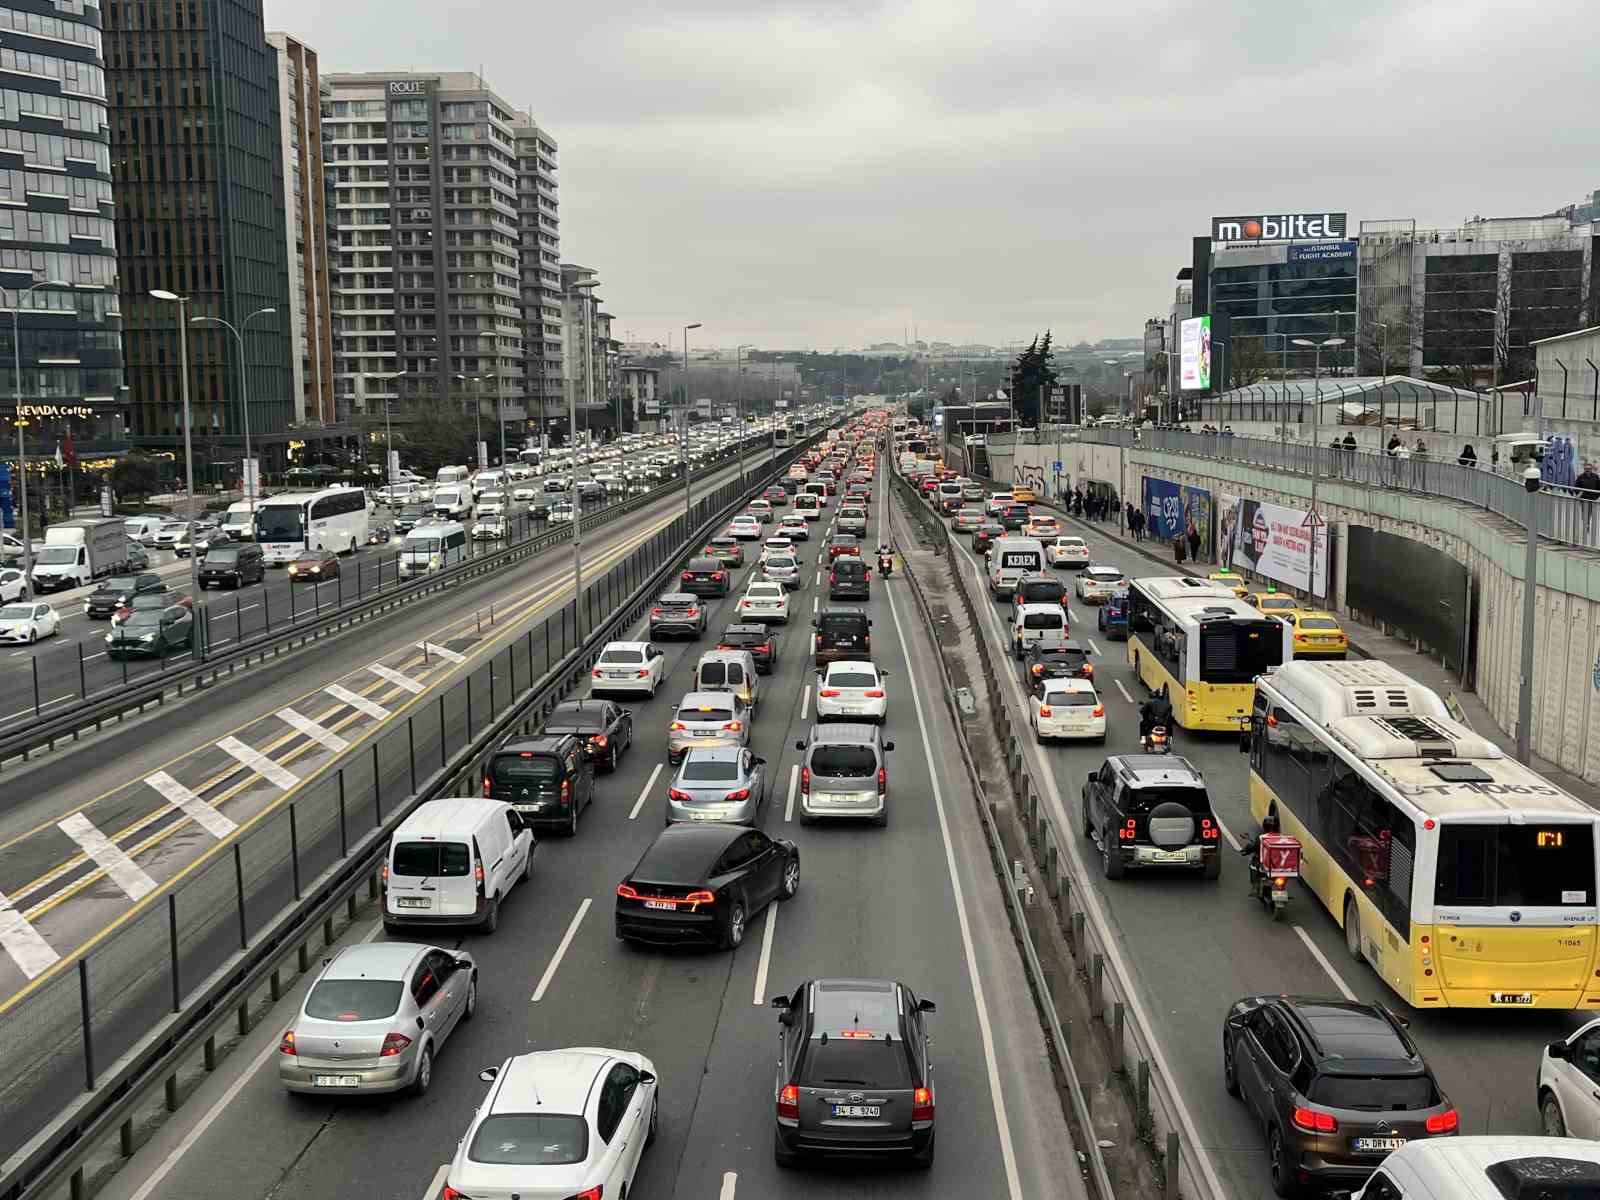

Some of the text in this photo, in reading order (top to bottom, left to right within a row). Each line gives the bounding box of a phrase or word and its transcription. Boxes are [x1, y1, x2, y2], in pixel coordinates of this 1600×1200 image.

[390, 81, 424, 92] ROUTE
[1321, 249, 1352, 258] ACADEMY
[16, 406, 58, 415] NEVADA
[1007, 554, 1036, 567] KEREM
[1360, 1139, 1369, 1148] 34
